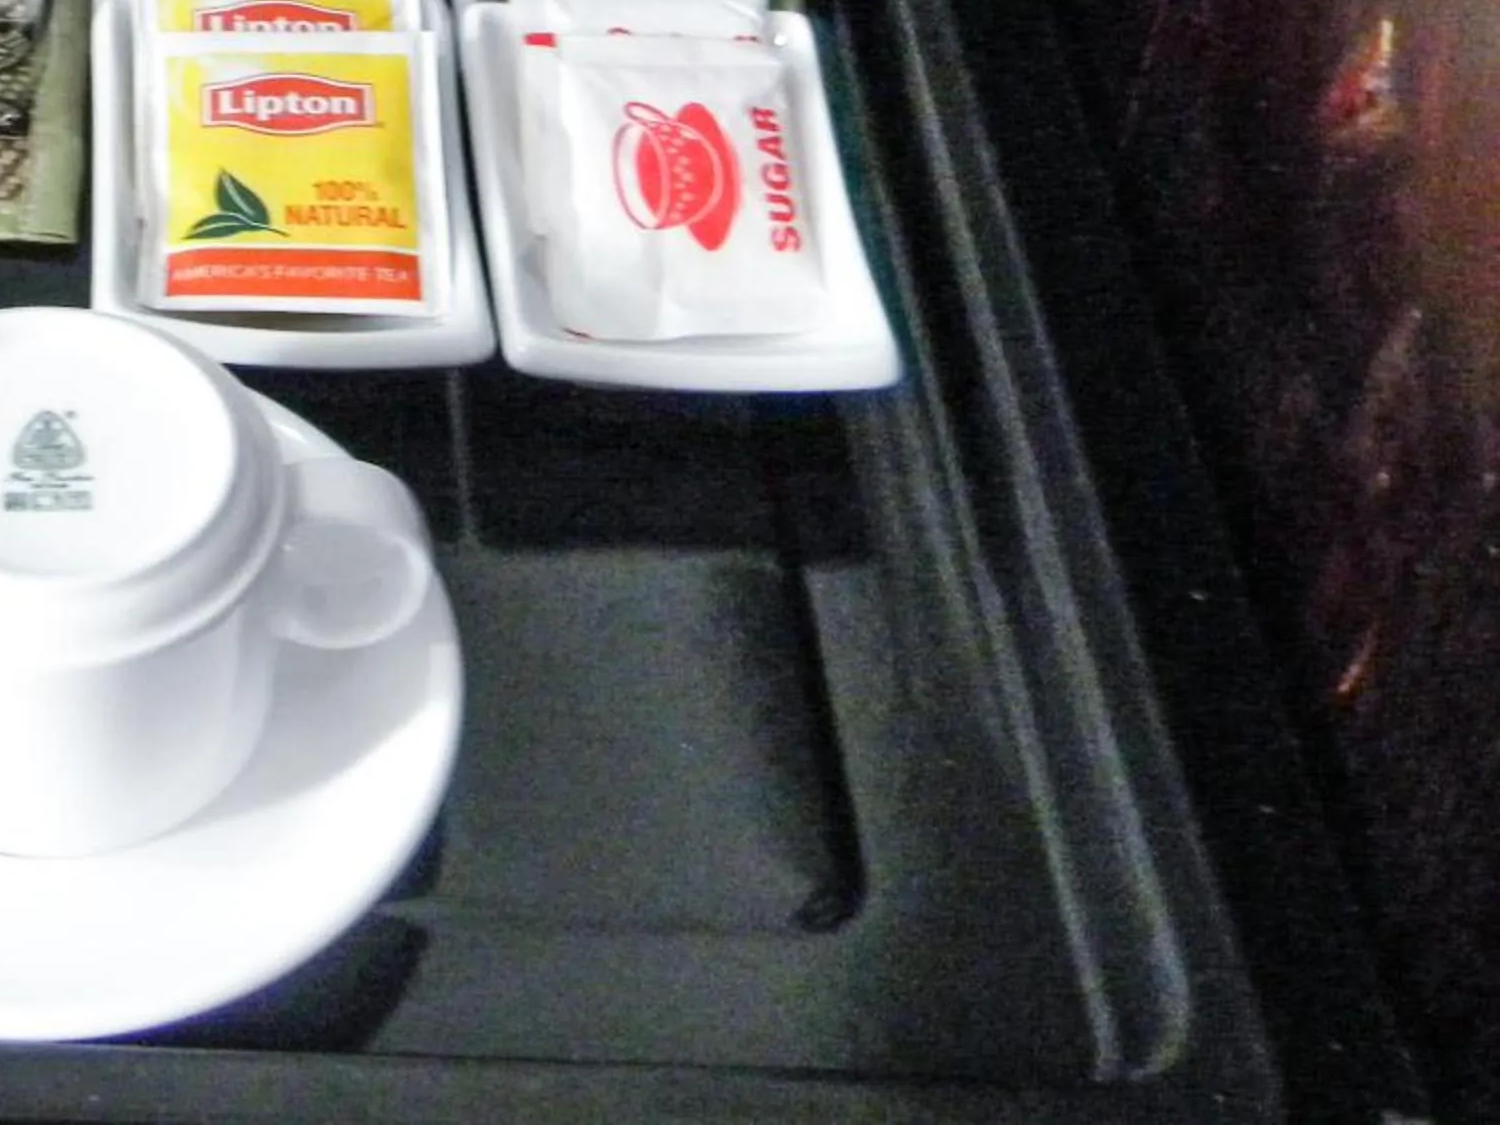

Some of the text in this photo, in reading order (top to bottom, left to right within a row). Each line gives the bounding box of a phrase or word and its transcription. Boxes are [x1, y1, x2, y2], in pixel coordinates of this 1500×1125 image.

[216, 89, 358, 121] Lipton
[313, 179, 379, 202] 100%
[747, 106, 802, 253] SUGAR
[285, 205, 407, 229] NATURAL
